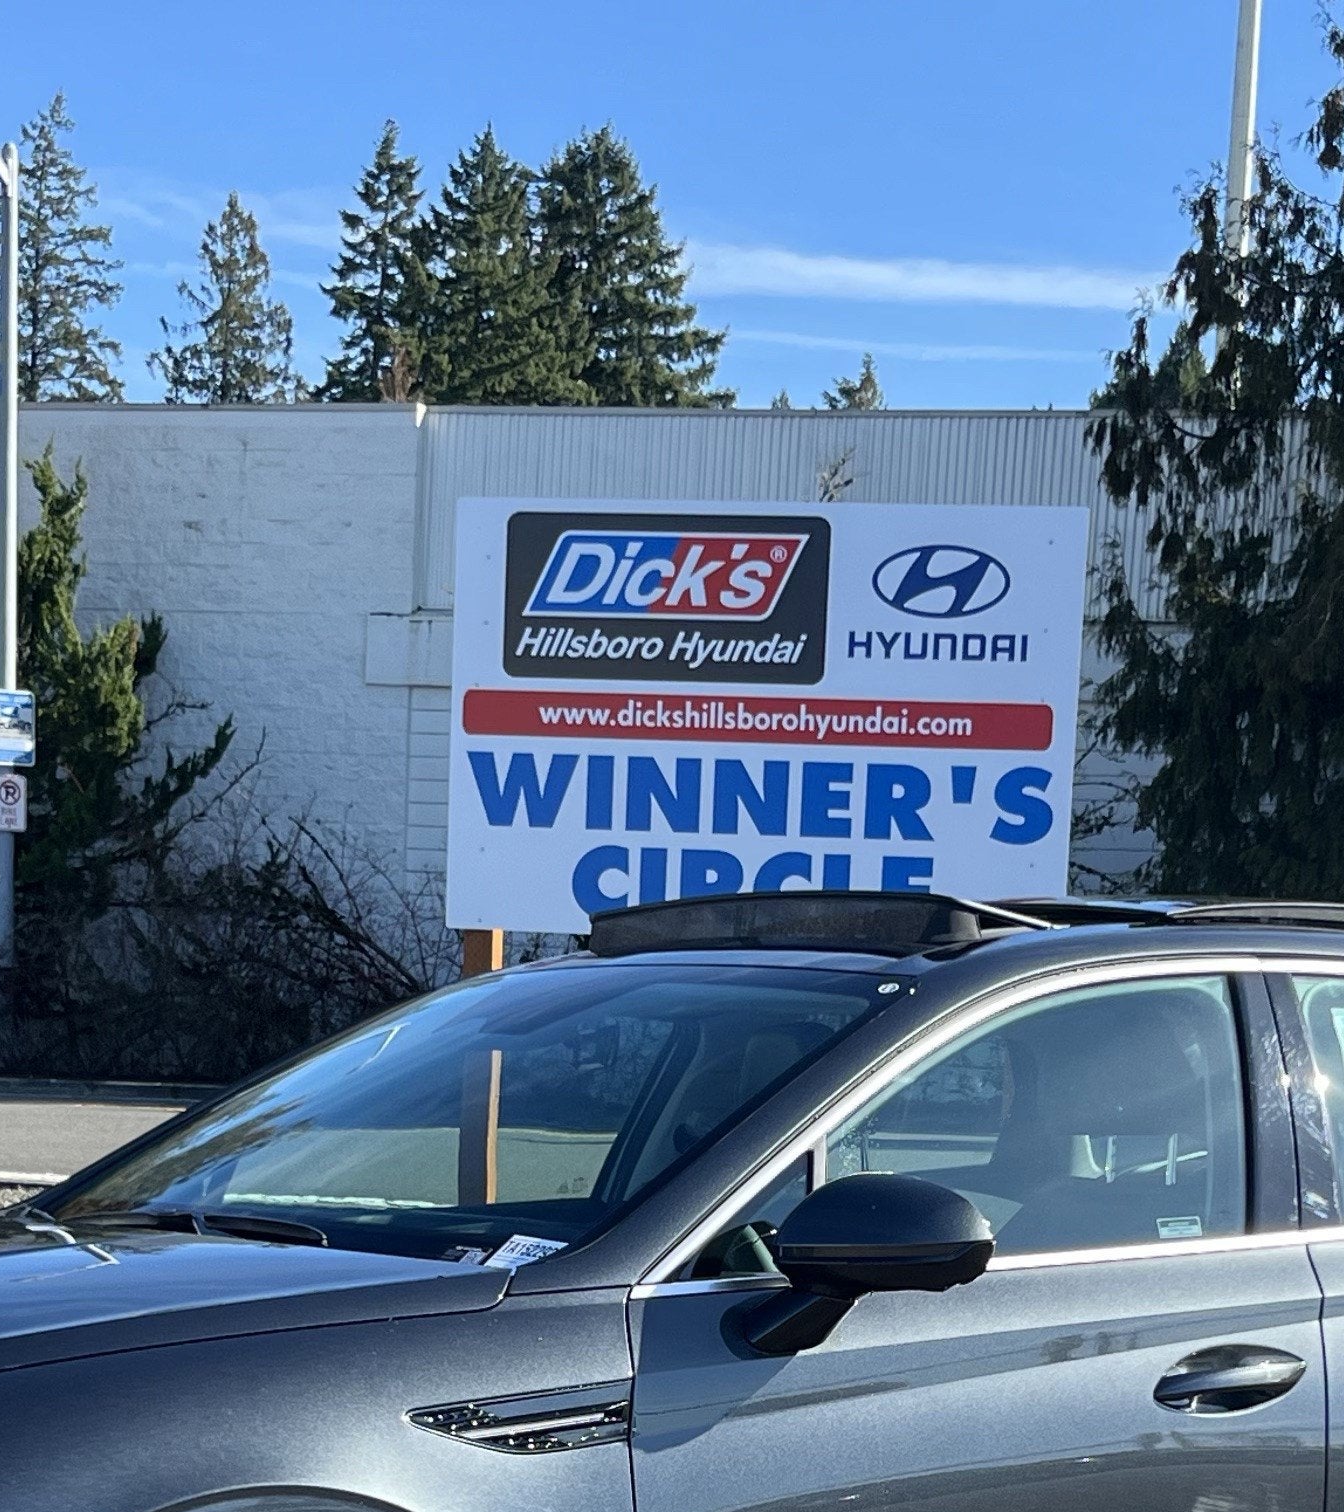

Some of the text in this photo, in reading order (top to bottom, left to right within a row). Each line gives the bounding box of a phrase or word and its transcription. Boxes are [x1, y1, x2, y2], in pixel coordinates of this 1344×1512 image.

[546, 541, 772, 609] Dick's
[515, 626, 807, 669] Hillsboro Hyundai
[848, 631, 1029, 662] HYUNDAI
[539, 700, 973, 741] www.dickshillsborohyundai.com
[466, 750, 1054, 846] WINNER'S
